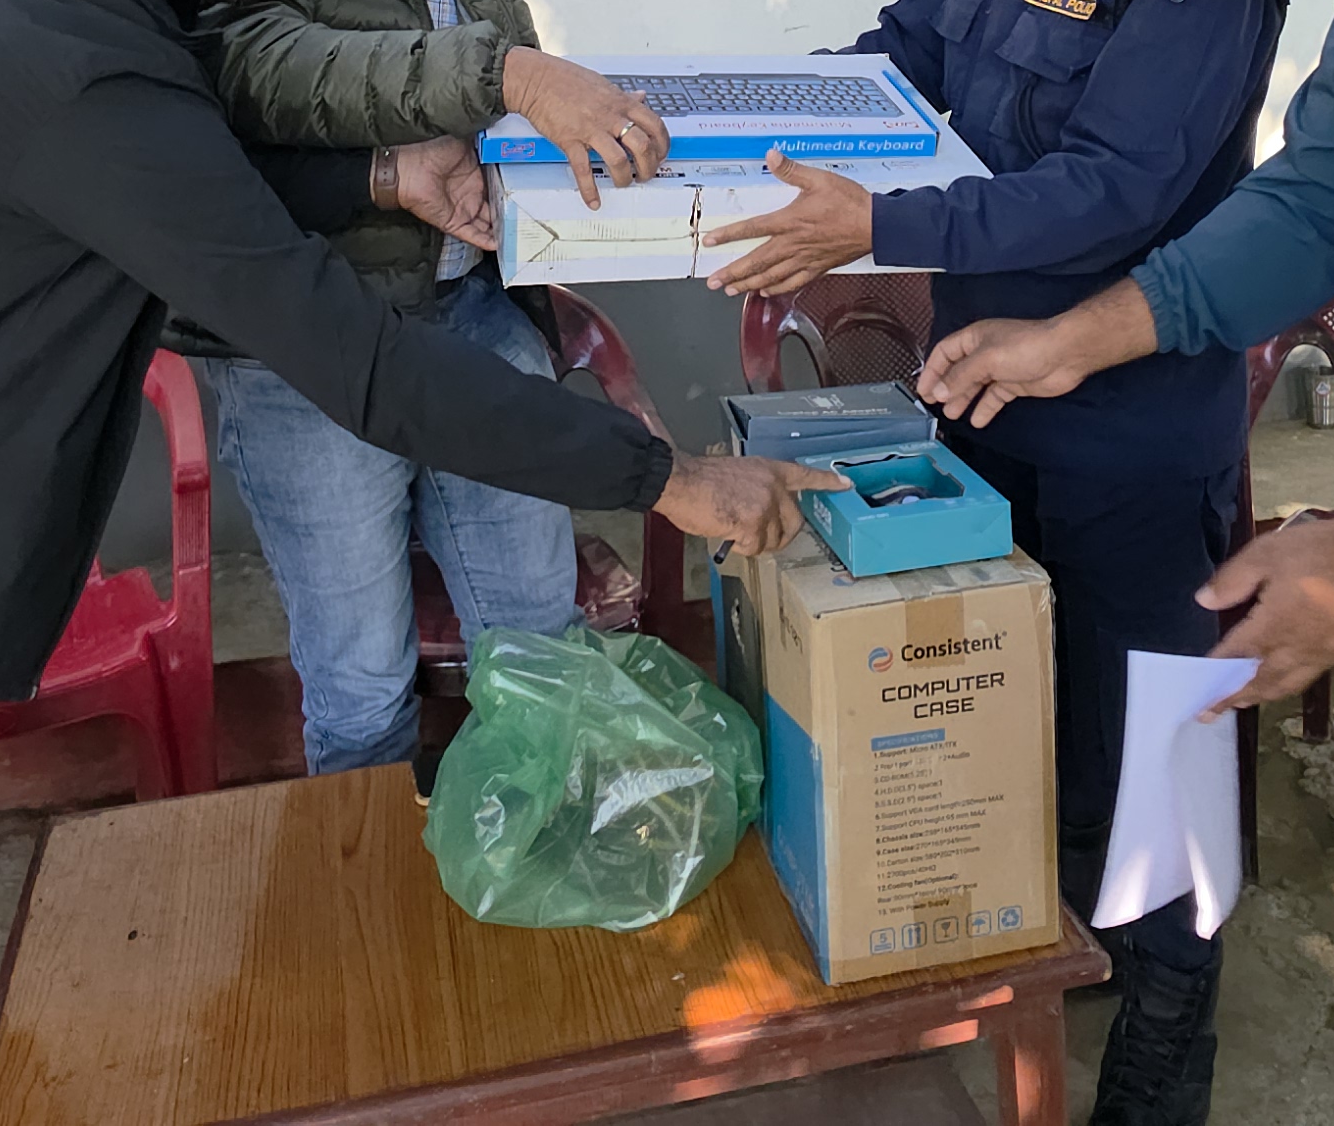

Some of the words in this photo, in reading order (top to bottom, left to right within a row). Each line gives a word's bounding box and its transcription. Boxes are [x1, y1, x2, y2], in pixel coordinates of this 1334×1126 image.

[773, 140, 854, 152] Multimedia
[858, 139, 925, 154] Keyboard
[901, 633, 1003, 662] Consistent
[881, 672, 1005, 703] COMPUTER
[914, 697, 975, 719] CASE
